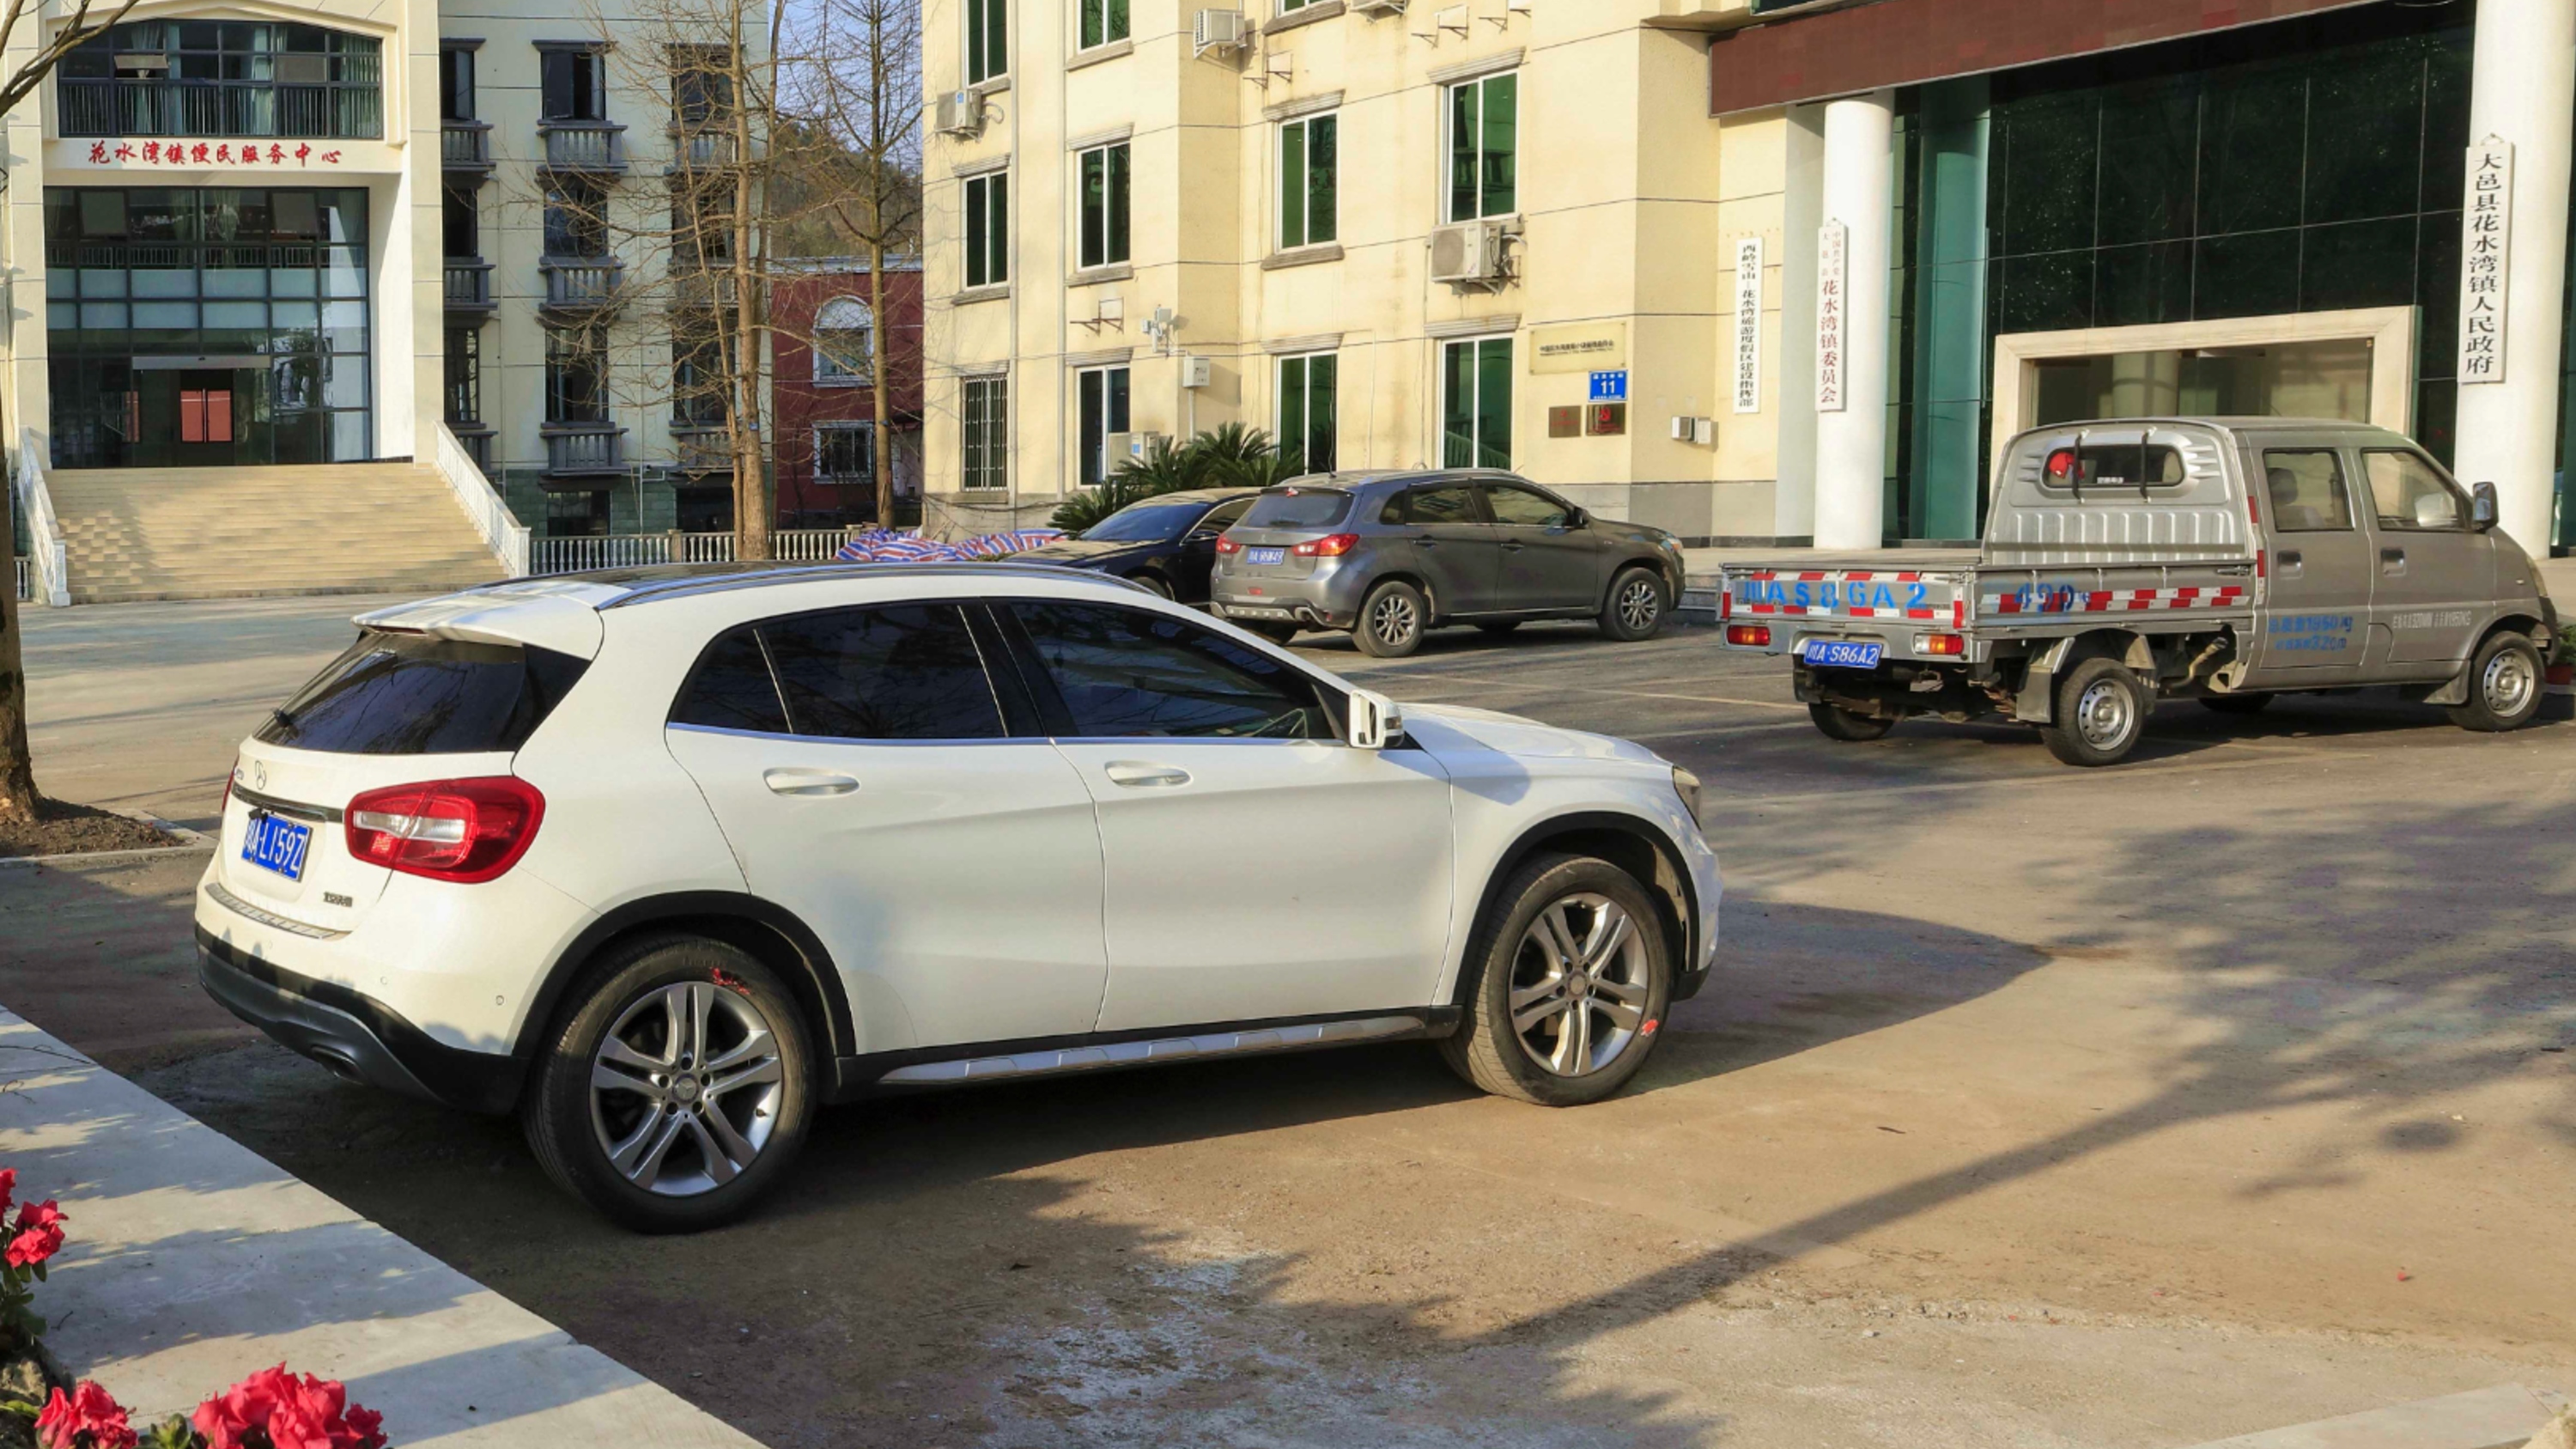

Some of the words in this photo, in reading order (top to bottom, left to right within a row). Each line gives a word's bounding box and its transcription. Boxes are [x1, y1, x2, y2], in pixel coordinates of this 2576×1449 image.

[88, 139, 342, 167] 花水湾镇便民服务中心
[2465, 153, 2502, 374] 大邑县花水湾镇人民政府
[1820, 279, 1839, 403] 花水湾镇委员会
[1601, 380, 1615, 394] 11
